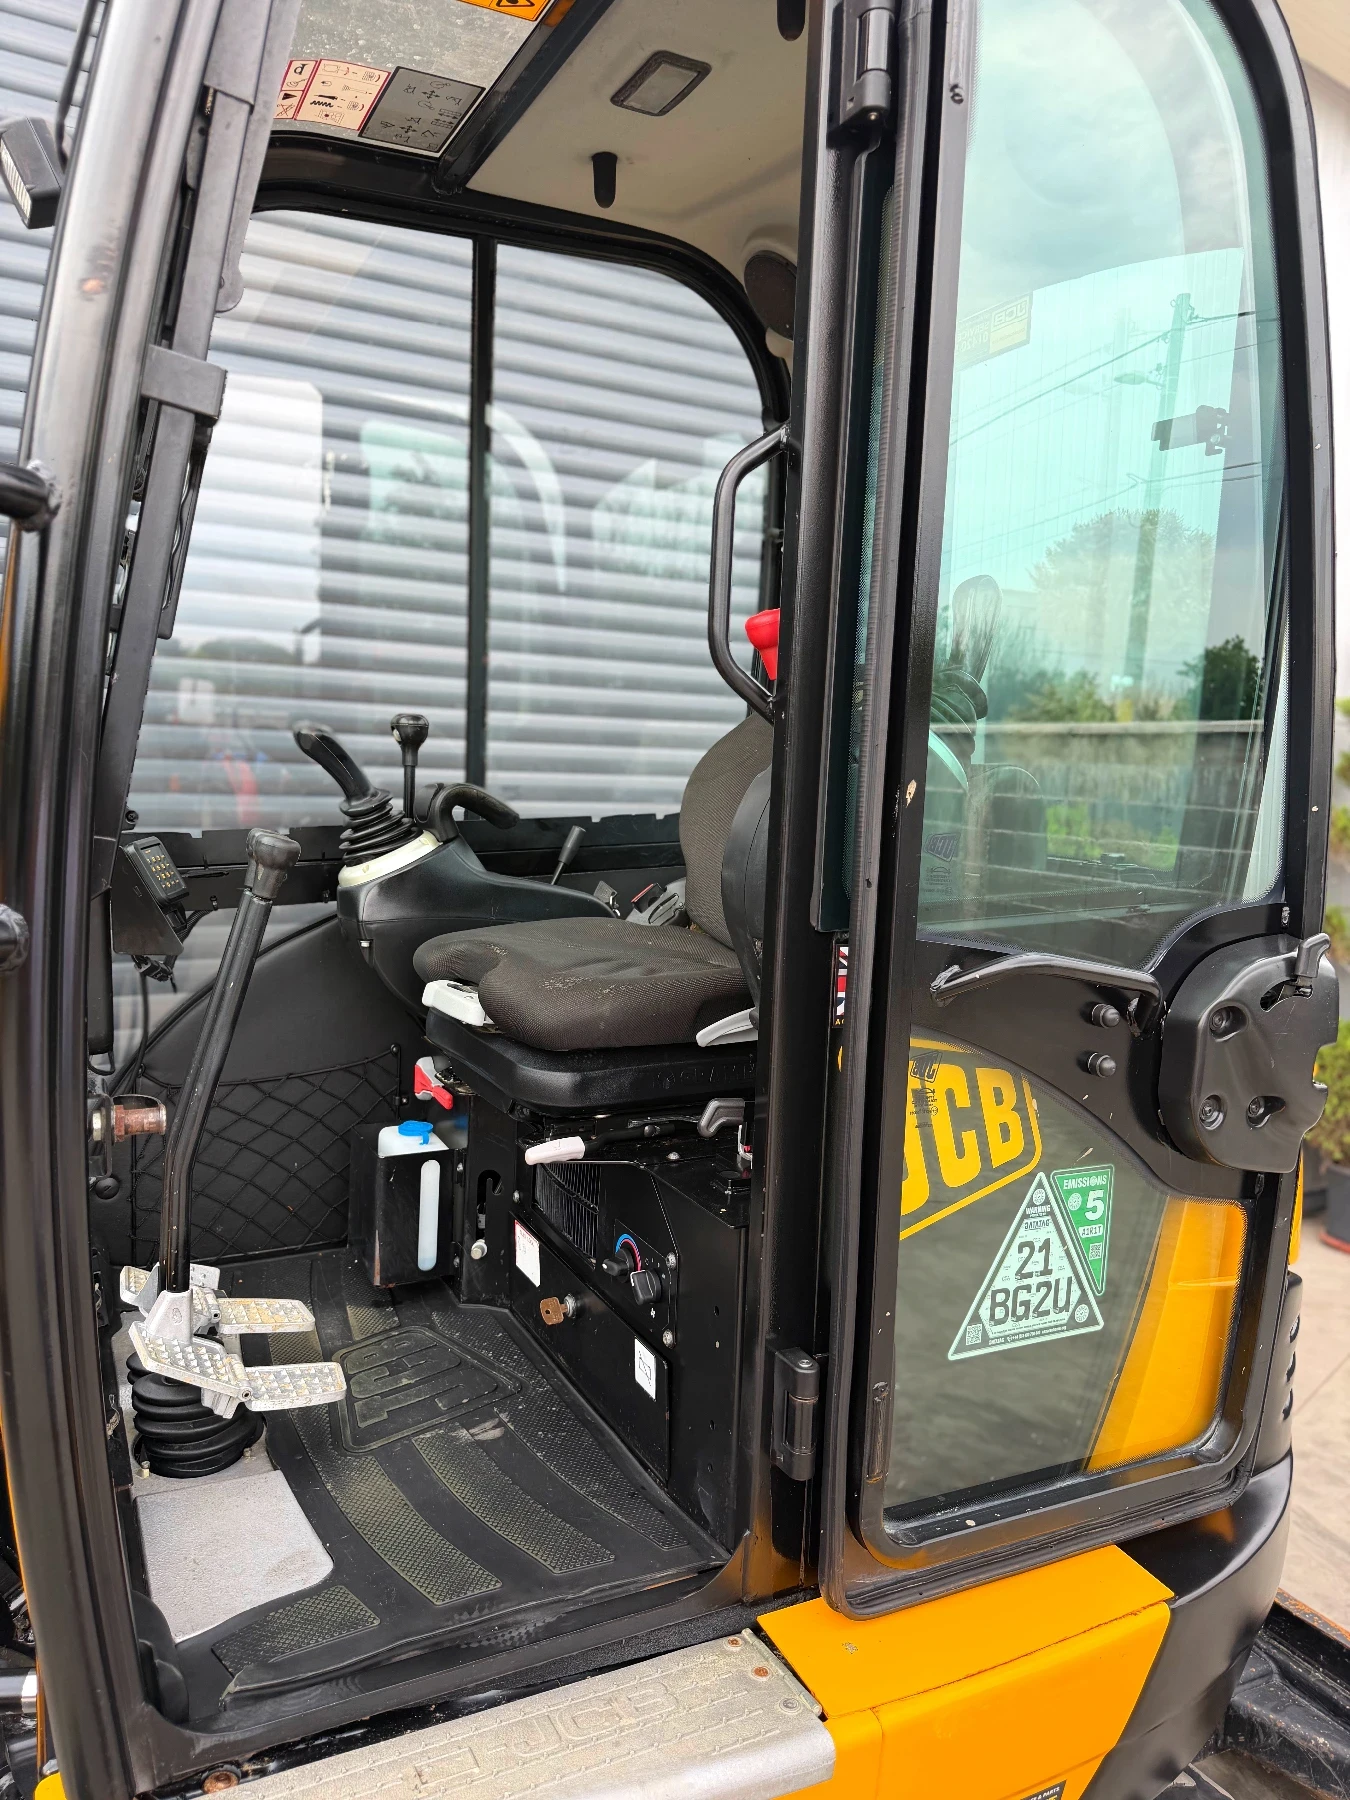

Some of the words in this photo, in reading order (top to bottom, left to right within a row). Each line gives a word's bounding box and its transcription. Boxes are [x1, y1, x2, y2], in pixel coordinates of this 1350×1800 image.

[1063, 1174, 1108, 1190] EMISSIONS
[1084, 1189, 1105, 1221] 5
[1015, 1238, 1053, 1280] 21
[989, 1276, 1073, 1327] BG2U
